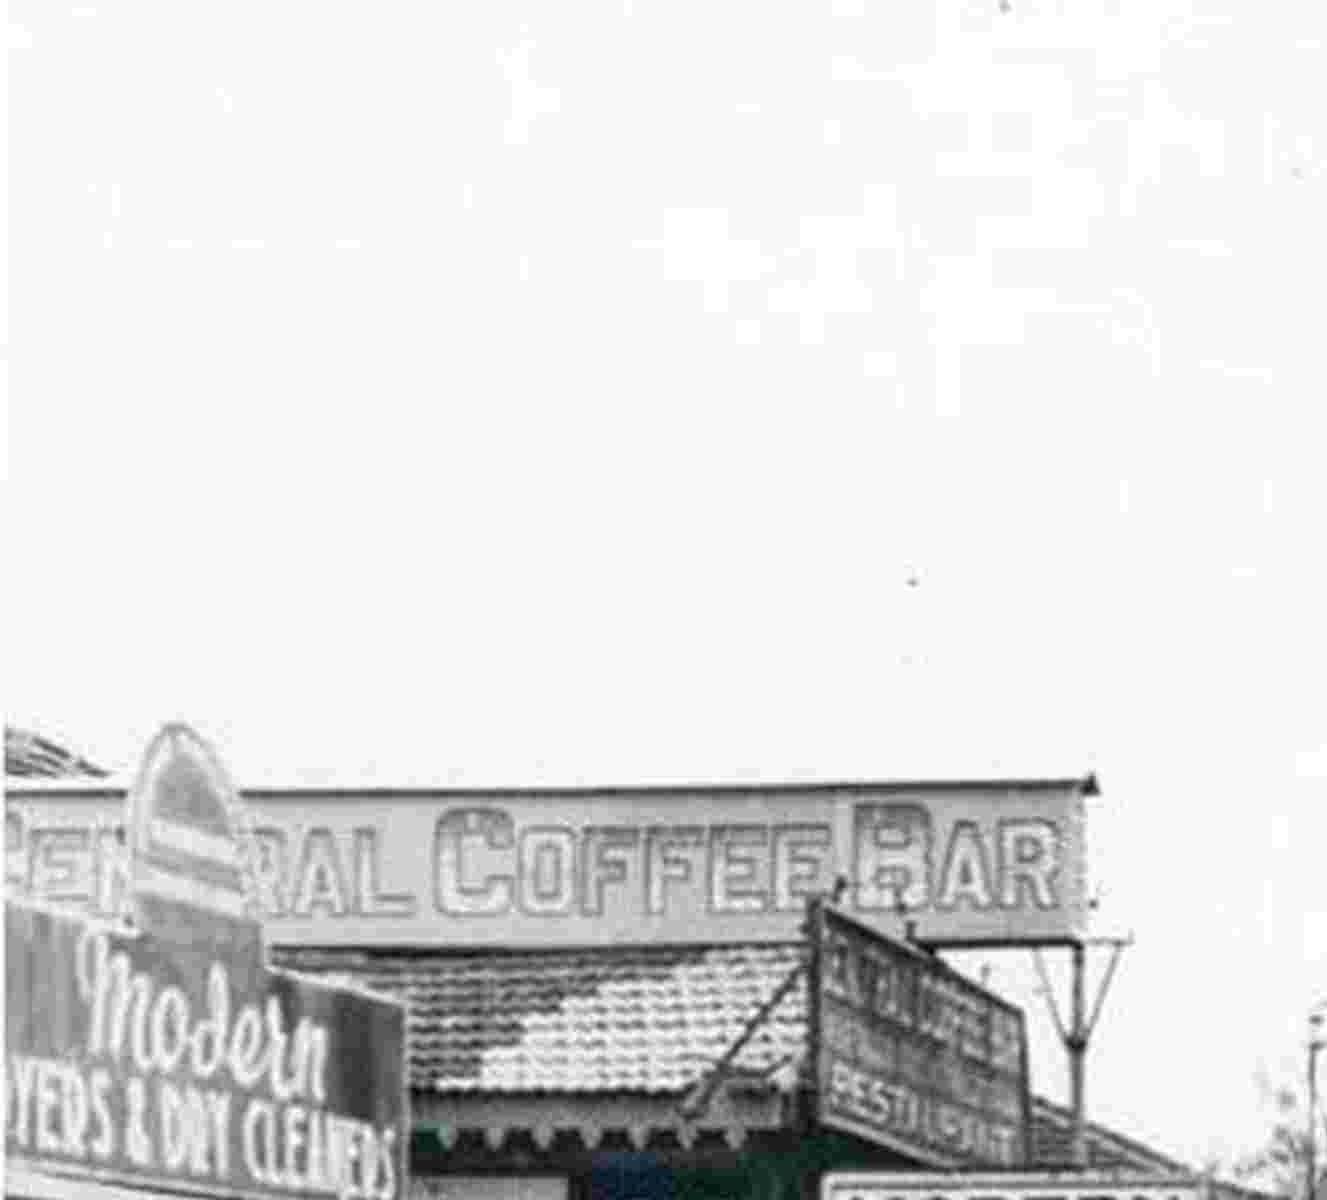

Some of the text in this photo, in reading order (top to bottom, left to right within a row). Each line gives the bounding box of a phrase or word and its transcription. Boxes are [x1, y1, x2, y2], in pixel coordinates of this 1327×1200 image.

[433, 807, 832, 917] COFFEE
[853, 802, 1060, 911] BAR
[77, 927, 328, 1101] Modern
[7, 1054, 113, 1164] YERS
